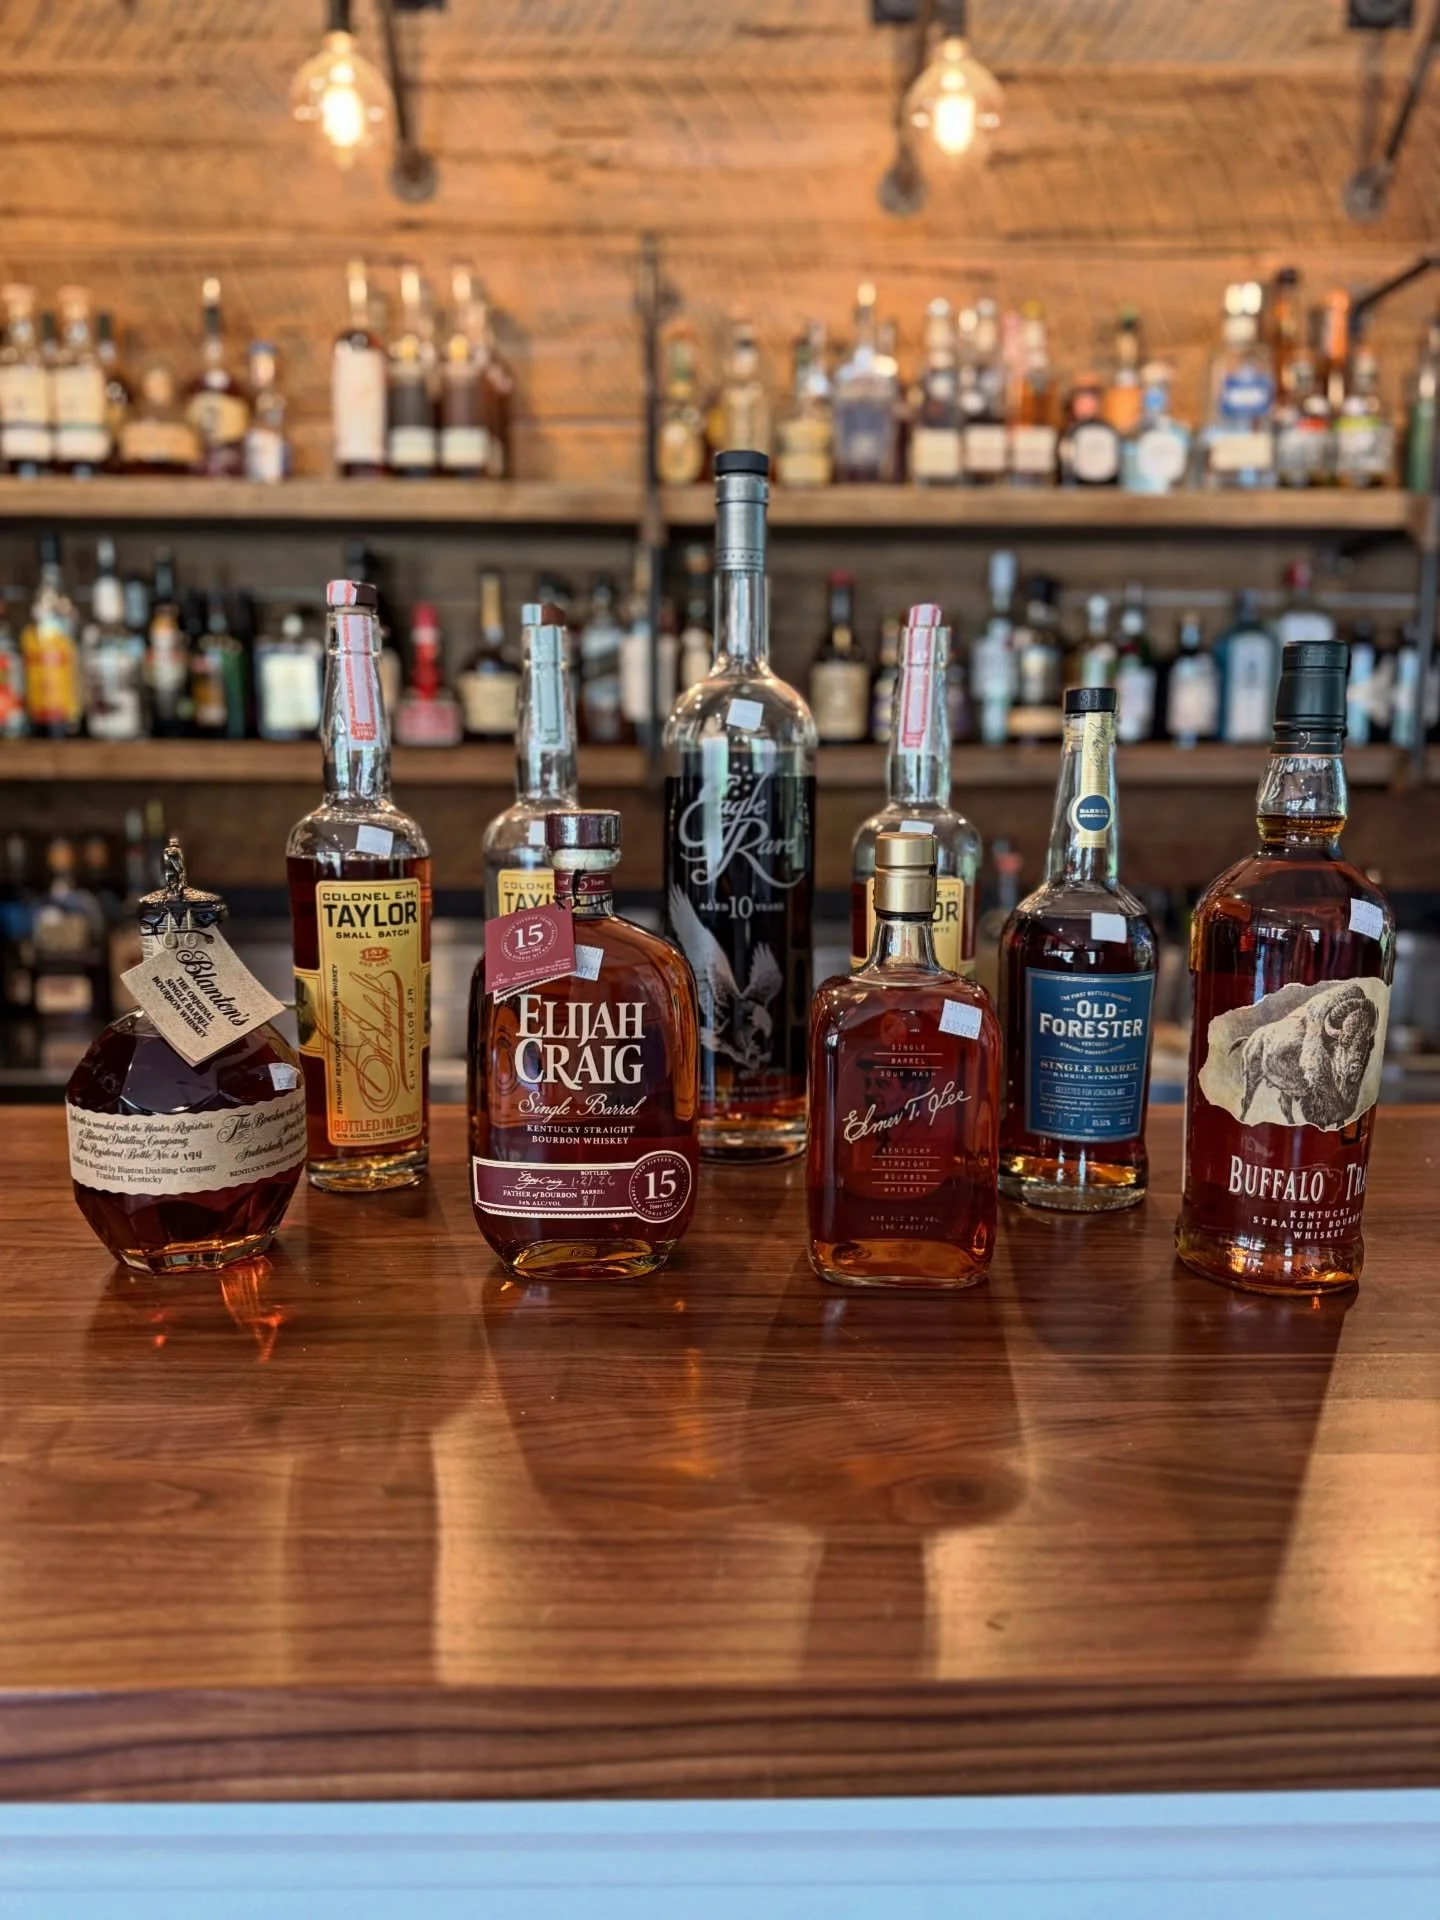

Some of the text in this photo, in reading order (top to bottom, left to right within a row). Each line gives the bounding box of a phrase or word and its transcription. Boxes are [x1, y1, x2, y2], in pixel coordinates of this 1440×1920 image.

[323, 890, 416, 901] COLONEL E.H.
[504, 882, 553, 890] COLONE
[323, 901, 417, 928] TAYLOR
[700, 902, 729, 911] AGED
[728, 896, 754, 919] 10
[378, 929, 410, 938] BATCH
[514, 923, 544, 949] 15
[176, 950, 250, 1026] Blanton's
[177, 976, 214, 1021] THE ORIGINAL
[152, 976, 208, 1038] BOURBON WHISKEY
[166, 978, 208, 1029] SINGLE BARREL
[1076, 1000, 1117, 1019] OLD
[516, 994, 647, 1047] ELIJAH
[1040, 1012, 1143, 1038] FORESTER
[515, 1038, 644, 1090] CRAIG
[1040, 1060, 1138, 1073] SINGLE BARREL
[1053, 1072, 1085, 1080] BARREL
[519, 1091, 647, 1123] Single Barrel
[842, 1104, 904, 1144] Elmer
[928, 1080, 972, 1126] Lee
[131, 1123, 140, 1132] the
[217, 1113, 251, 1143] This
[335, 1120, 380, 1132] BOTTLED
[381, 1117, 393, 1129] IN
[527, 1124, 635, 1134] KENTUCKY STRAIGHT
[532, 1136, 580, 1144] BOURBON
[180, 1165, 216, 1173] Company
[1228, 1155, 1368, 1202] BUFFALO TRA
[644, 1169, 677, 1200] 15
[1253, 1216, 1322, 1229] STRAIGHT
[1290, 1208, 1350, 1218] KENTUCKY
[1294, 1228, 1345, 1240] WHISKEY
